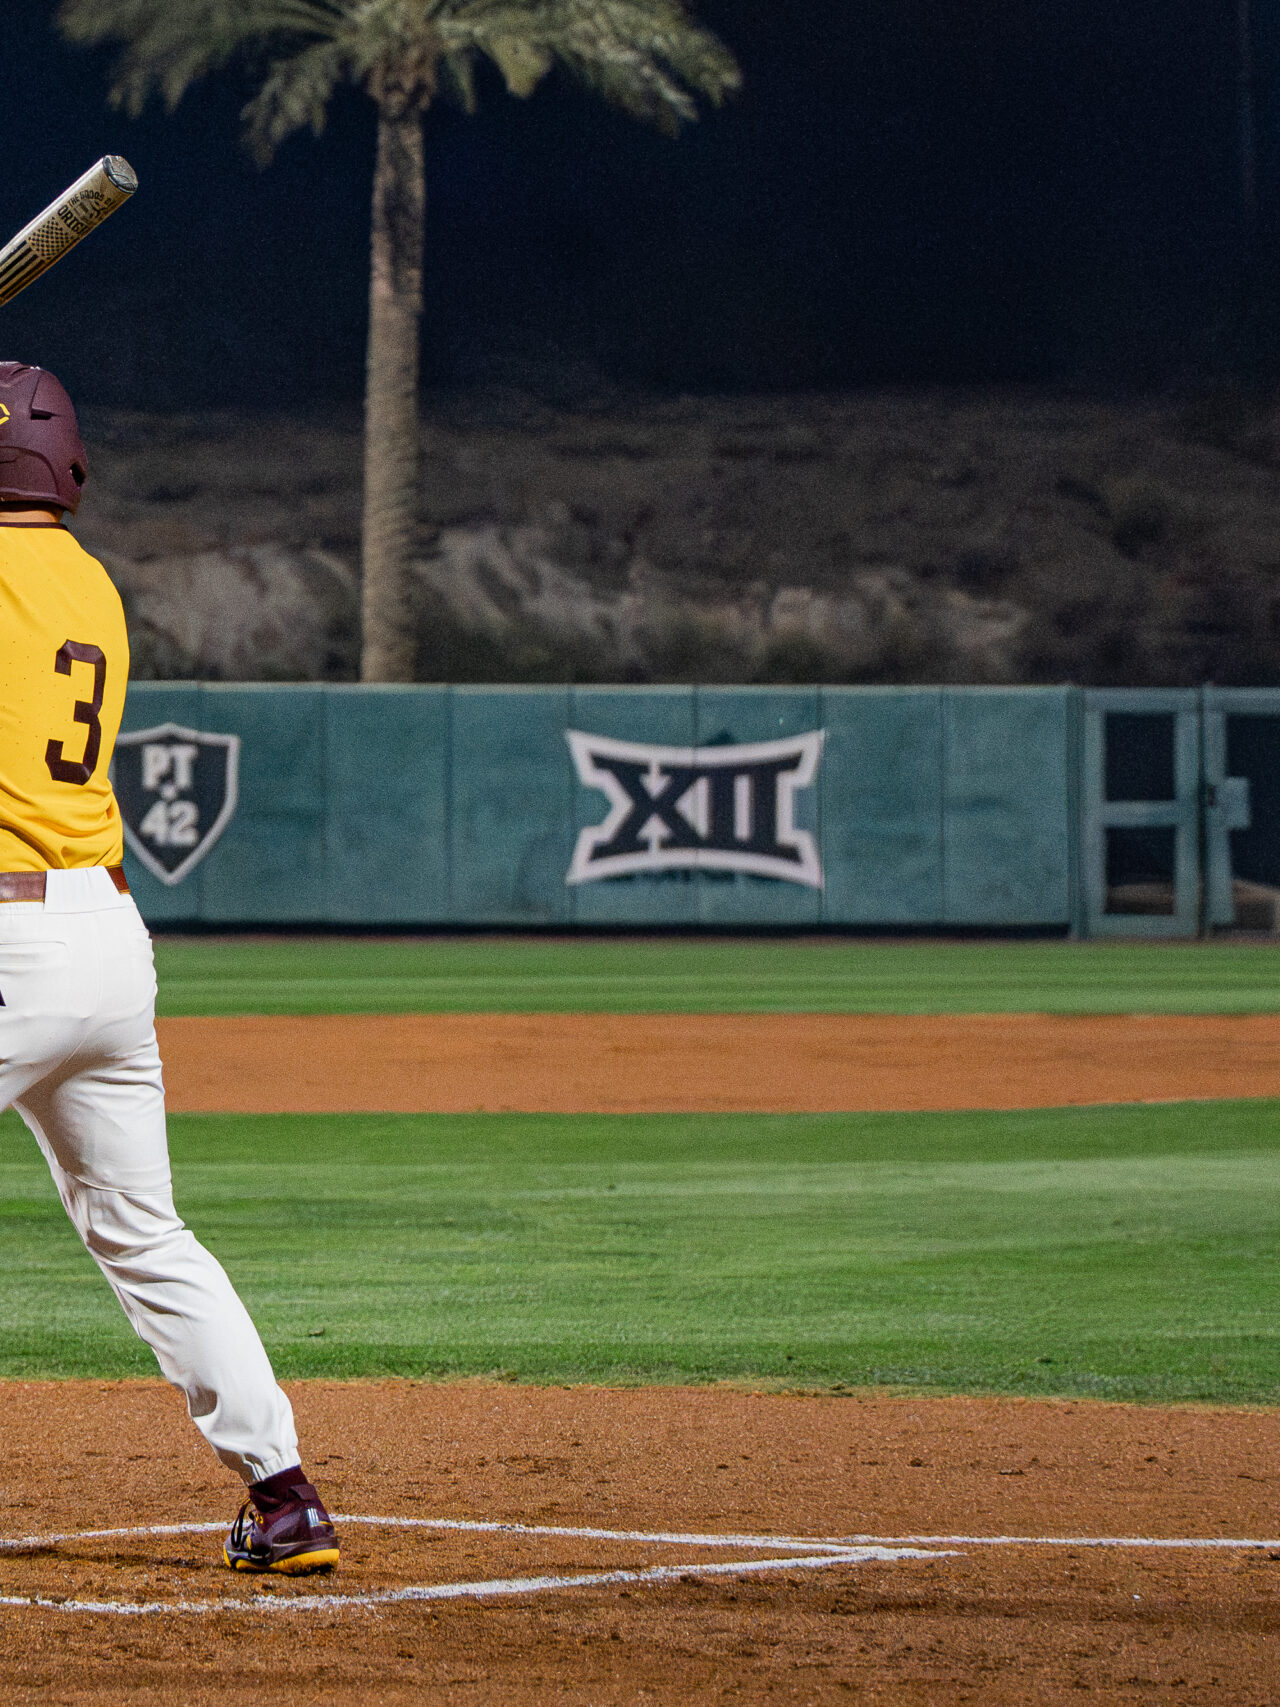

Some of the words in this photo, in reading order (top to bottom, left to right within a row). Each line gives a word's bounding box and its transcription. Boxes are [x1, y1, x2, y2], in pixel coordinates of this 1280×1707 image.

[57, 204, 91, 235] ORIGI
[67, 193, 80, 207] THE
[80, 190, 104, 201] GOODS
[44, 638, 107, 786] 3
[141, 743, 198, 791] PT
[140, 801, 200, 847] 42
[580, 746, 810, 869] XII
